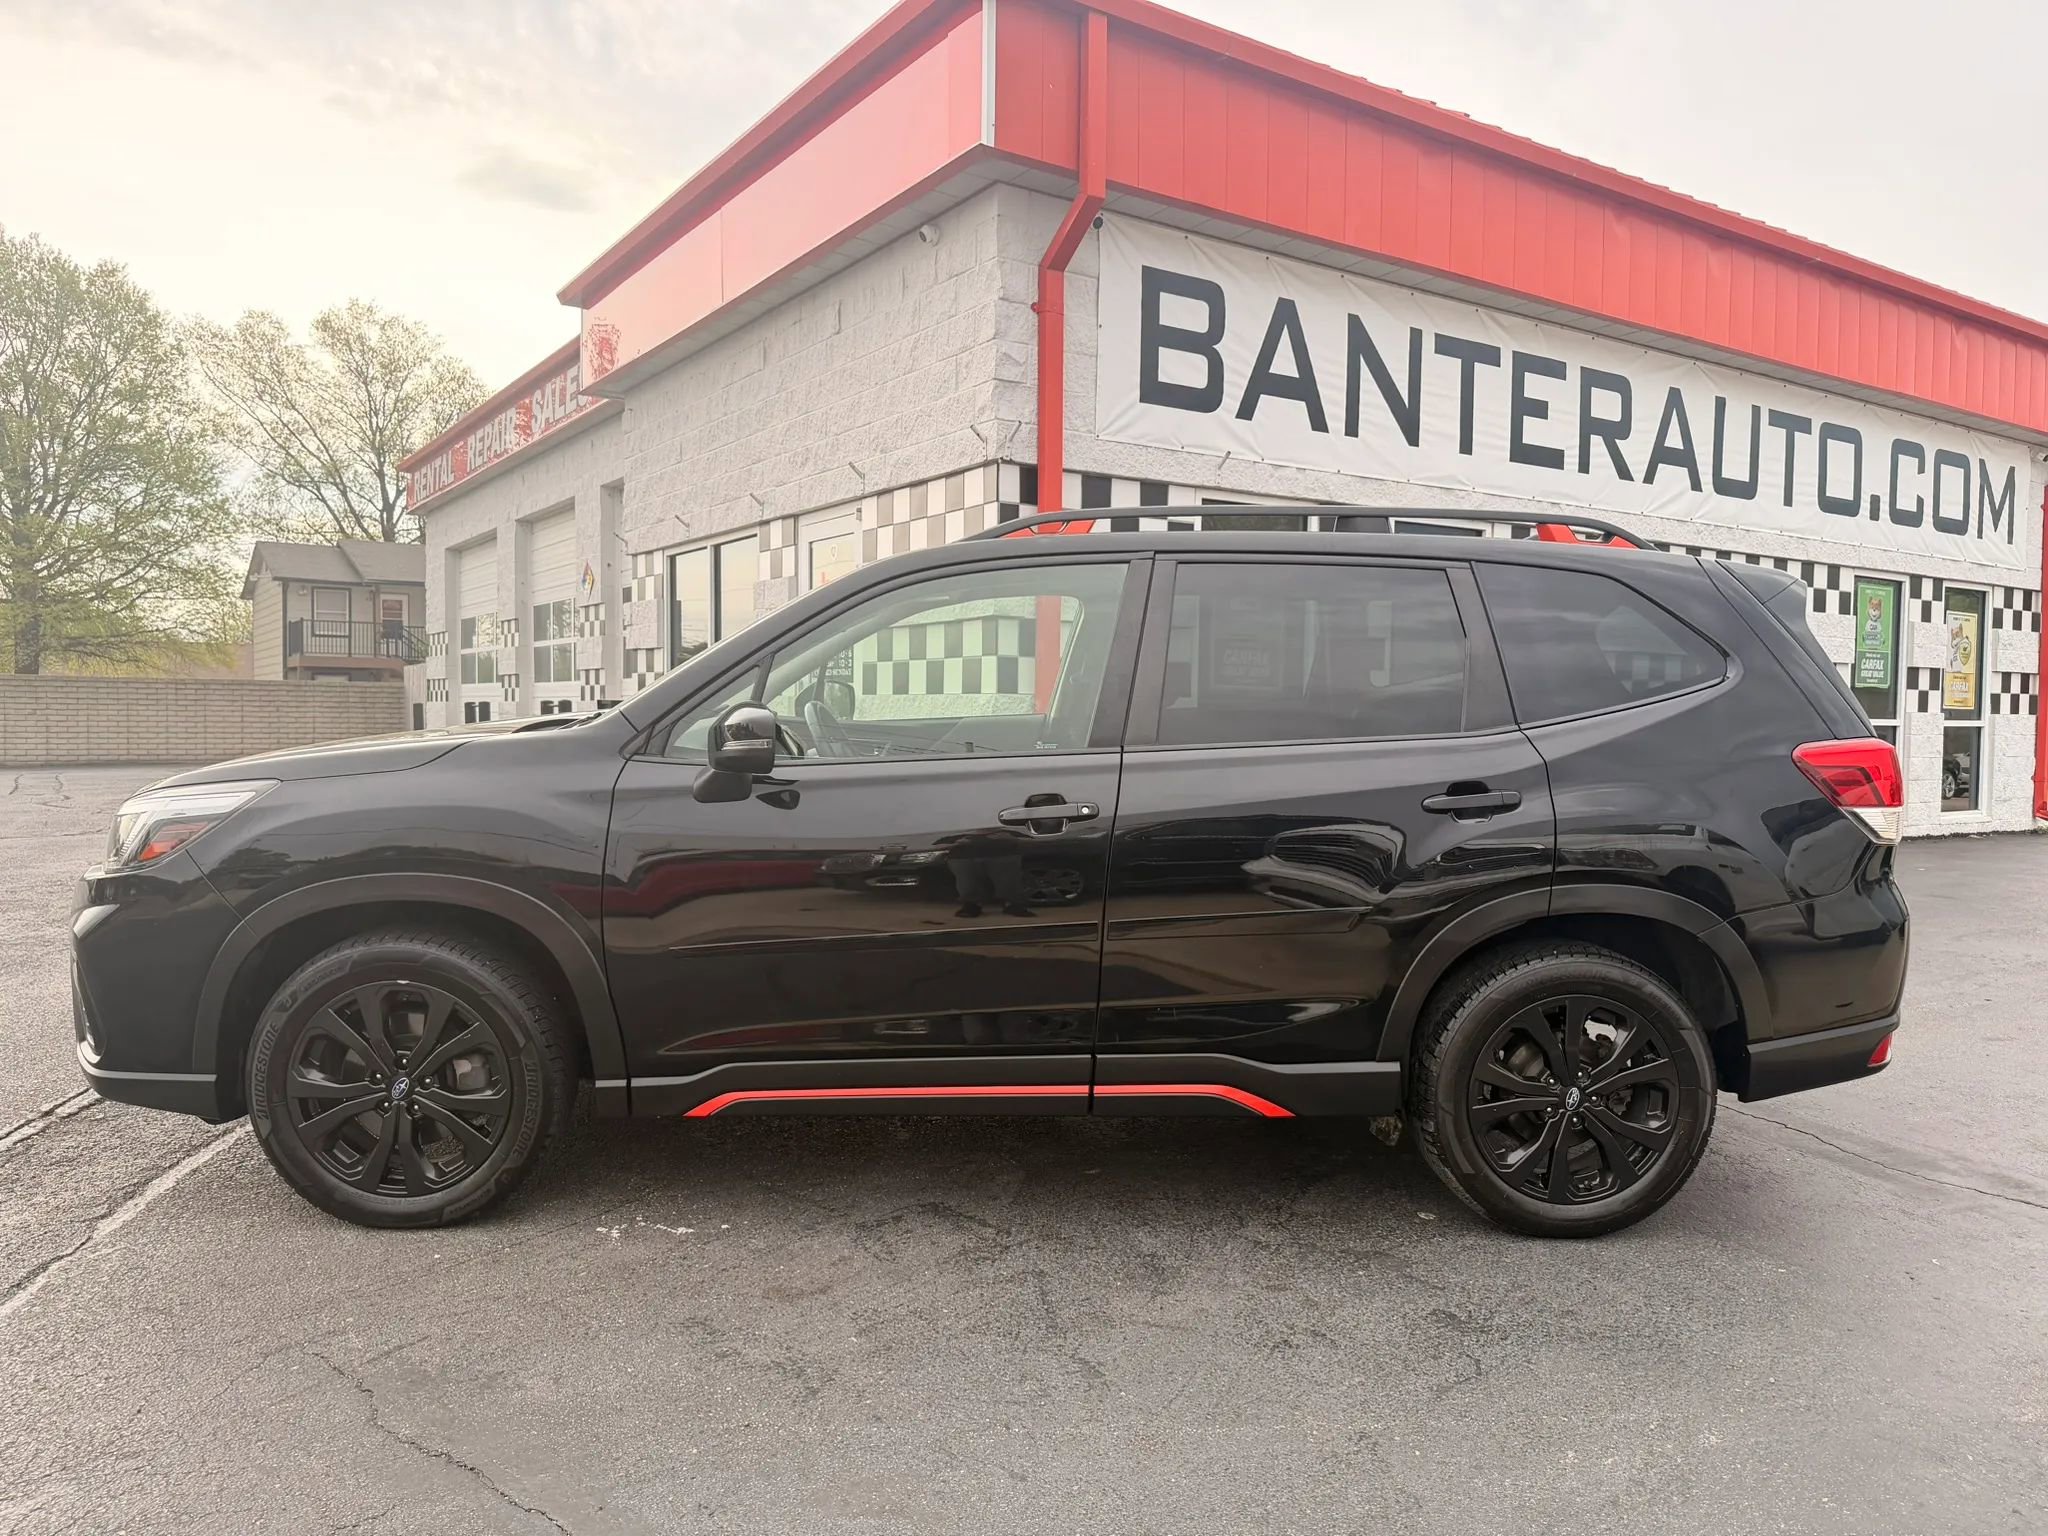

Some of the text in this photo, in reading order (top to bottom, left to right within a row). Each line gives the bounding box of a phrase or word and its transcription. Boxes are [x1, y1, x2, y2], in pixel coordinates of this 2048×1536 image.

[414, 363, 588, 504] RENTAL REPAIR SALE
[1140, 265, 2017, 545] BANTERAUTO.COM
[1860, 658, 1884, 670] CARFAX
[254, 1021, 280, 1121] BRIDGESTONE
[512, 1060, 540, 1160] BRIDGESTONE
